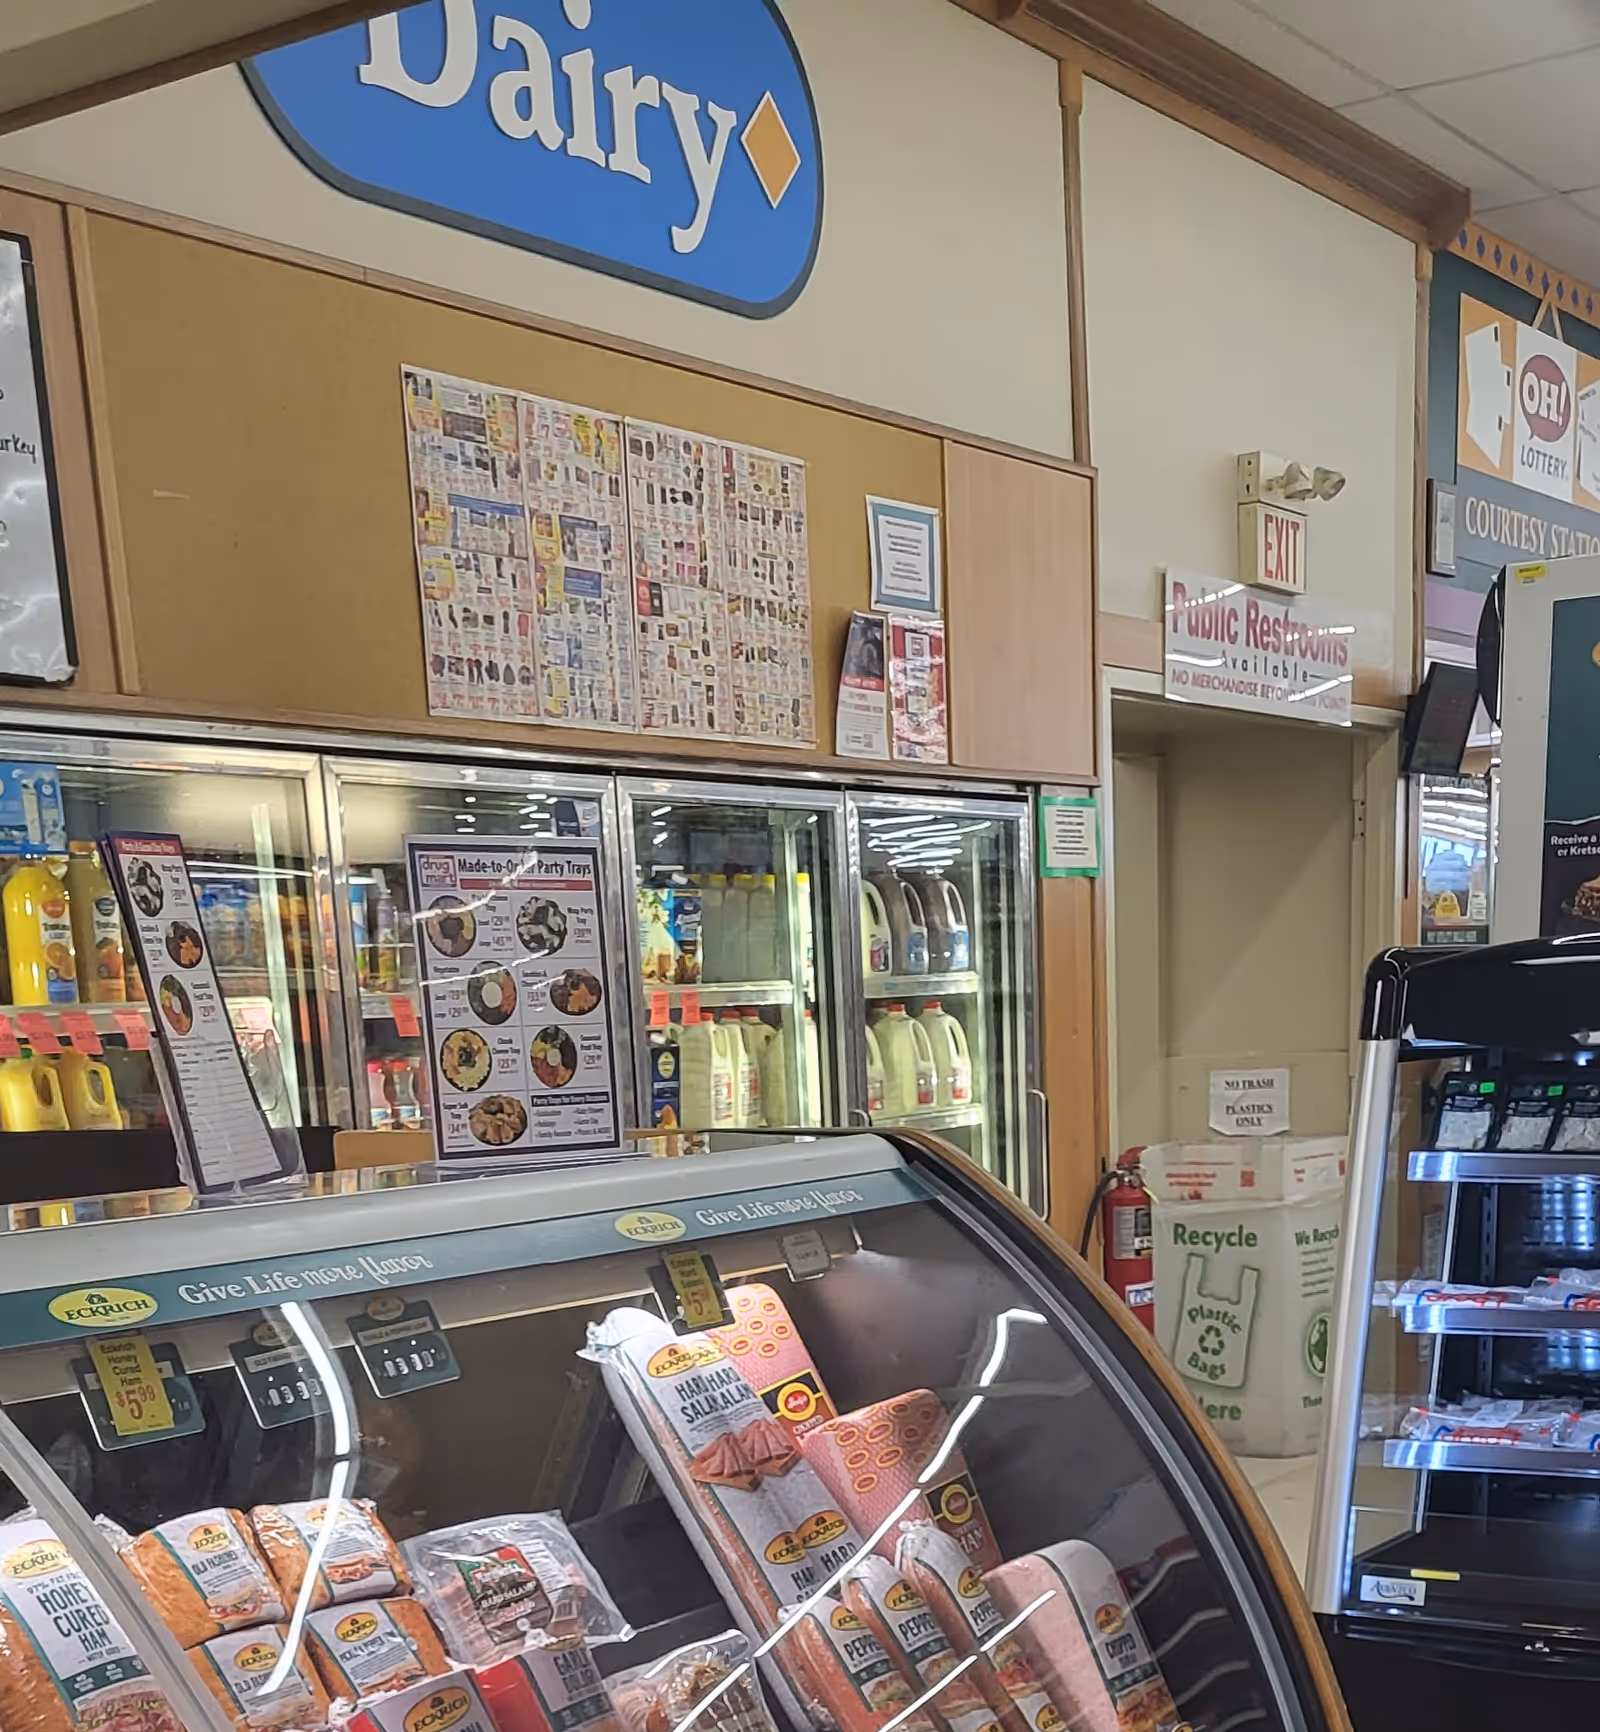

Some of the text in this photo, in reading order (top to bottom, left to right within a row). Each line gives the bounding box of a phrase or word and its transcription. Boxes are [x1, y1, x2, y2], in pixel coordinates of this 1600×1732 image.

[359, 0, 737, 254] Dairy
[1523, 371, 1567, 426] OH!
[1520, 444, 1567, 480] LOTTERY
[1465, 497, 1546, 555] COURTESY
[1264, 513, 1300, 585] EXIT
[1172, 582, 1348, 667] Public Restrooms
[1222, 650, 1308, 683] Available
[1172, 668, 1188, 686] NO
[1191, 671, 1258, 698] MERCHANDISE
[1551, 834, 1582, 846] Receive
[1558, 846, 1567, 857] or
[422, 858, 449, 875] drug
[426, 873, 456, 884] mart
[538, 859, 565, 877] Party
[567, 862, 592, 878] Trays
[1225, 1079, 1274, 1089] NO TRASH
[1225, 1104, 1273, 1115] PLASTICS
[1235, 1116, 1262, 1127] ONLY
[626, 1220, 683, 1239] ECKRICH
[695, 1207, 741, 1227] Give
[743, 1198, 777, 1220] Life
[1173, 1223, 1258, 1252] Recycle
[1295, 1231, 1310, 1246] We
[63, 1251, 434, 1322] ECKRICH Give Life more flavor
[1187, 1304, 1243, 1335] Plastic
[107, 1355, 137, 1365] Honey
[112, 1364, 142, 1375] Cured
[1187, 1352, 1227, 1380] Bags
[120, 1377, 142, 1387] Ham
[53, 1605, 109, 1639] CURED
[78, 1627, 110, 1653] HAM
[413, 1696, 467, 1732] ECKRICH
